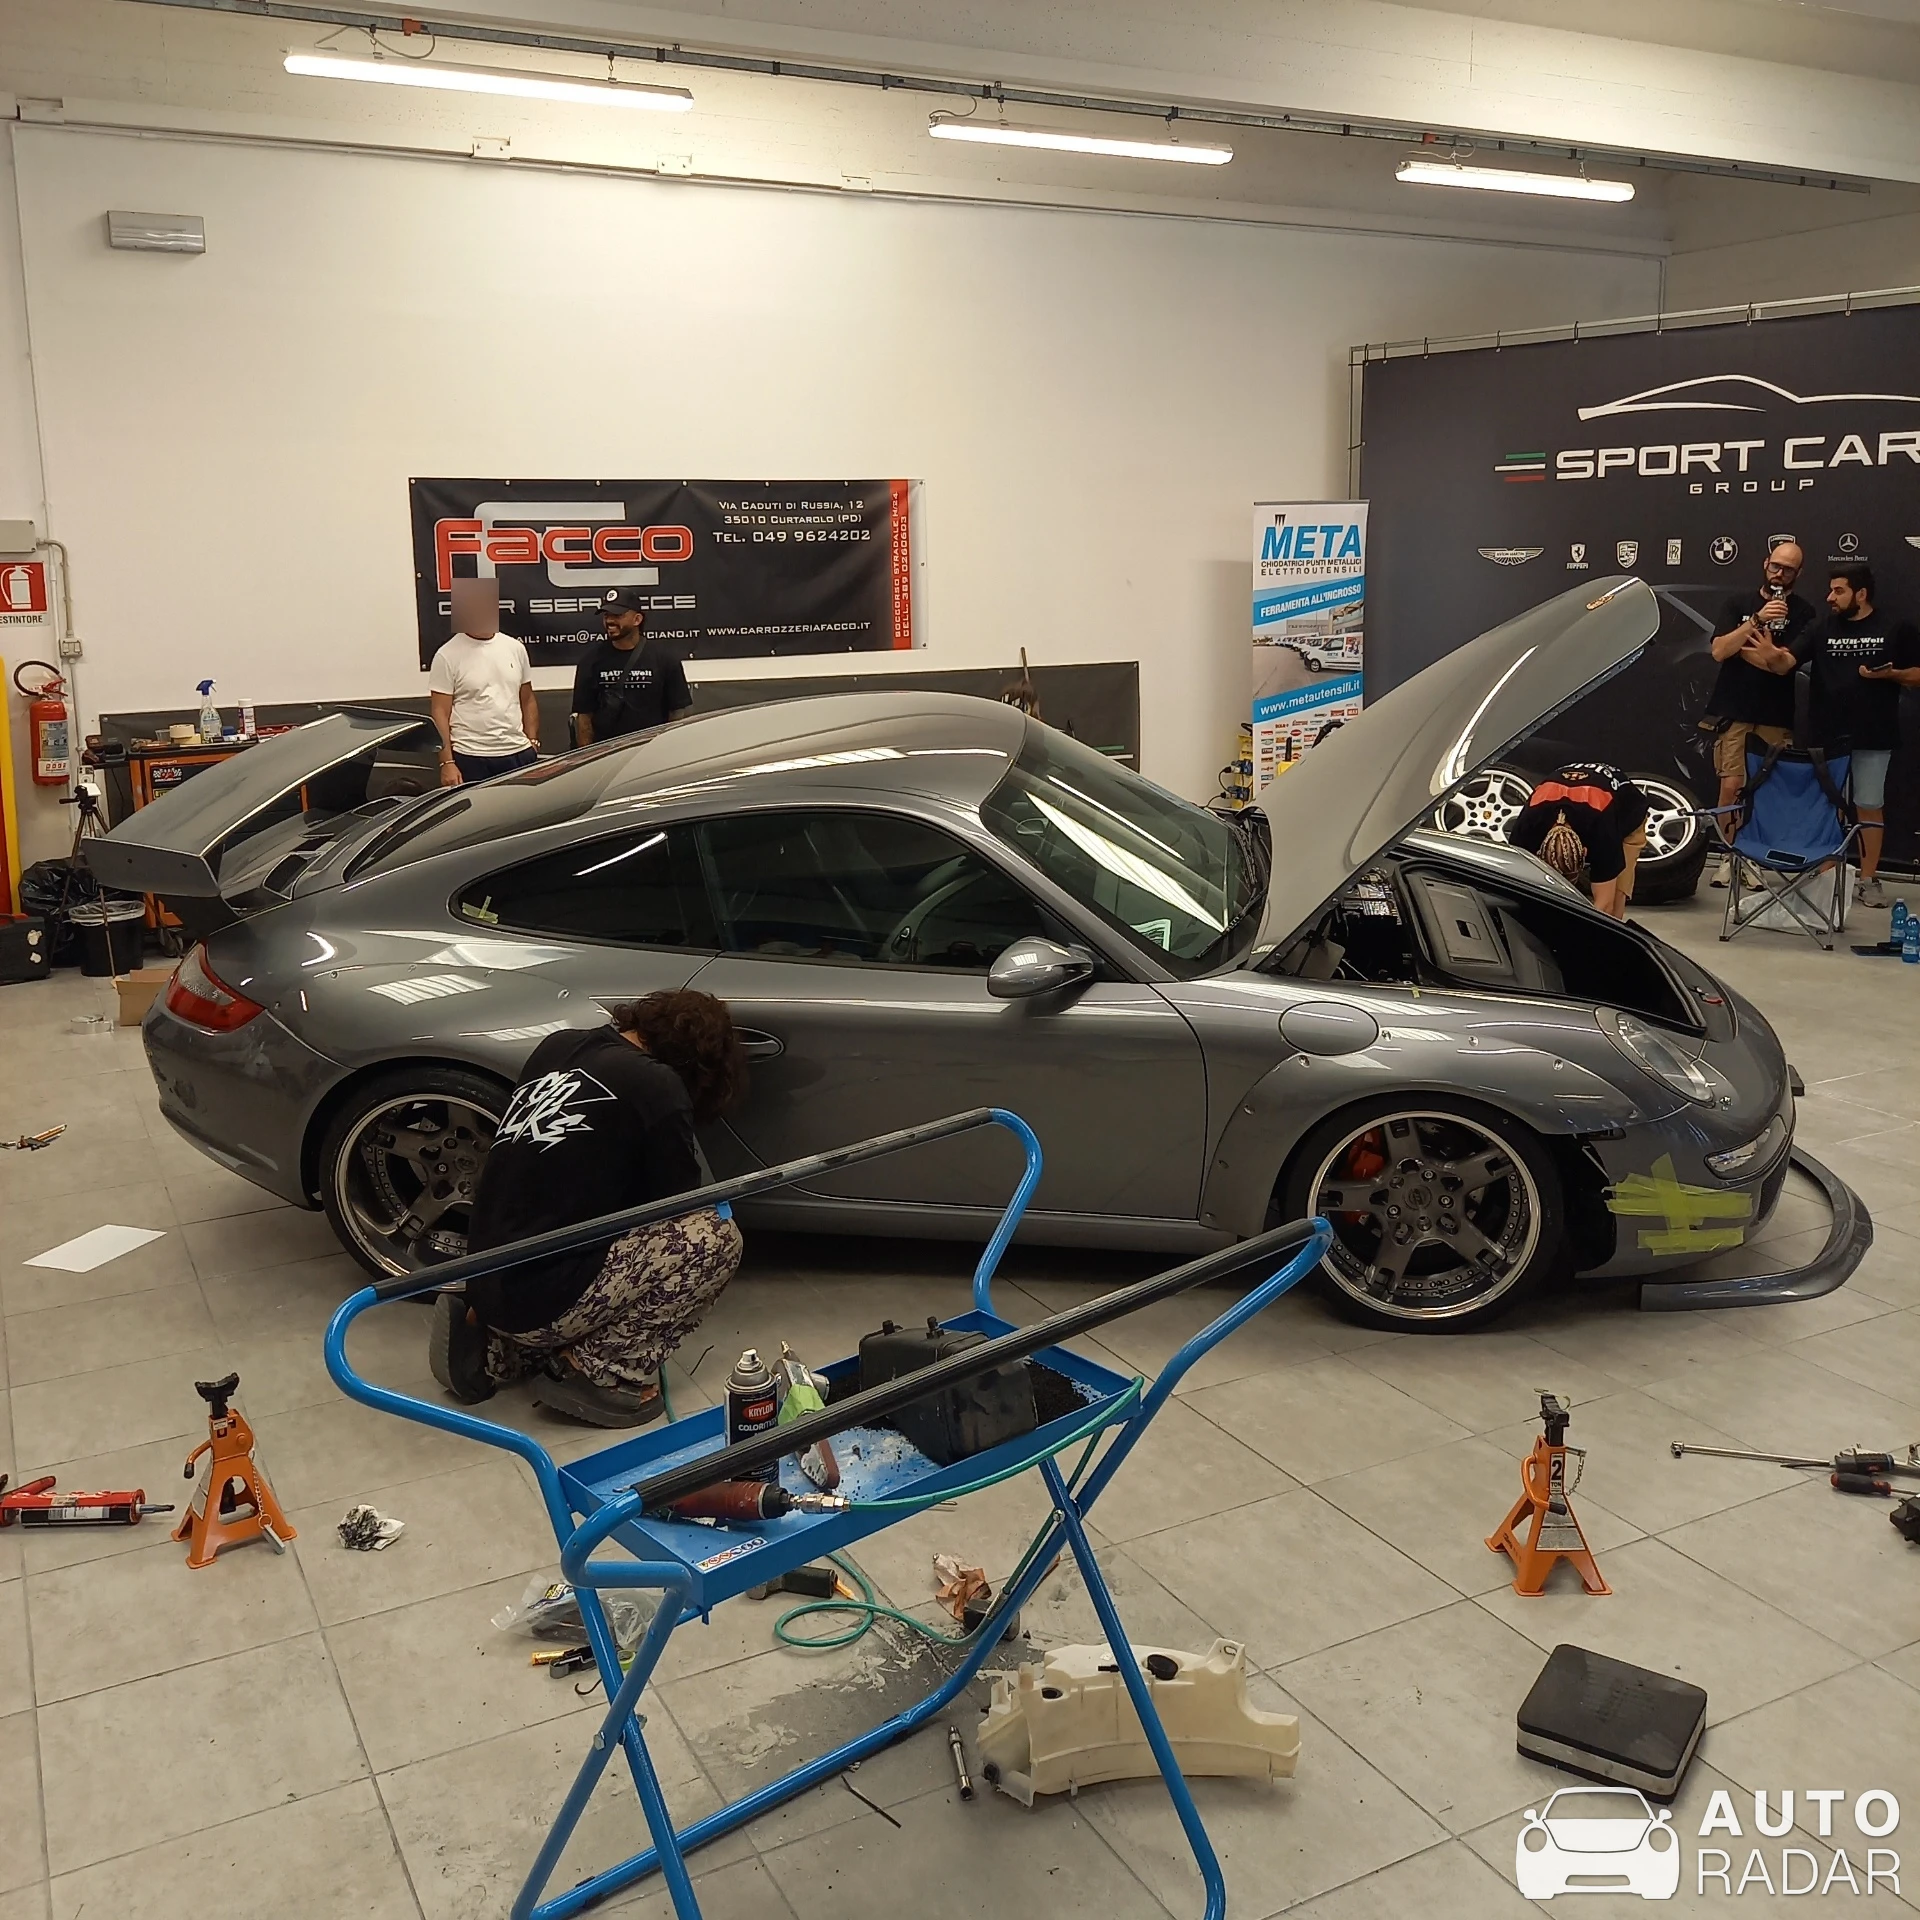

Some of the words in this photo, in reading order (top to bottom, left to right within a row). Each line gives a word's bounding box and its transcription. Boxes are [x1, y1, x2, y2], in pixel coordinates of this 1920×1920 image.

[1555, 440, 1765, 480] SPORT
[1783, 430, 1920, 470] CAR
[1689, 479, 1815, 494] GROUP
[848, 500, 864, 509] 12
[724, 515, 767, 524] 35010
[838, 514, 862, 523] (PD)
[753, 531, 787, 542] 049
[794, 530, 871, 542] 9624202
[1261, 524, 1362, 560] META
[1261, 560, 1304, 568] CHIODATRICI
[1306, 559, 1326, 567] PUNTI
[1327, 558, 1362, 566] METALLICI
[1261, 566, 1362, 576] ELETTROUTENSILI
[1260, 597, 1310, 618] FERRAMENTA
[1311, 584, 1362, 605] ALL'INGROSSO
[1260, 679, 1360, 715] www.metautensili.it
[748, 1402, 774, 1418] KRYLON
[1551, 1459, 1562, 1481] 2
